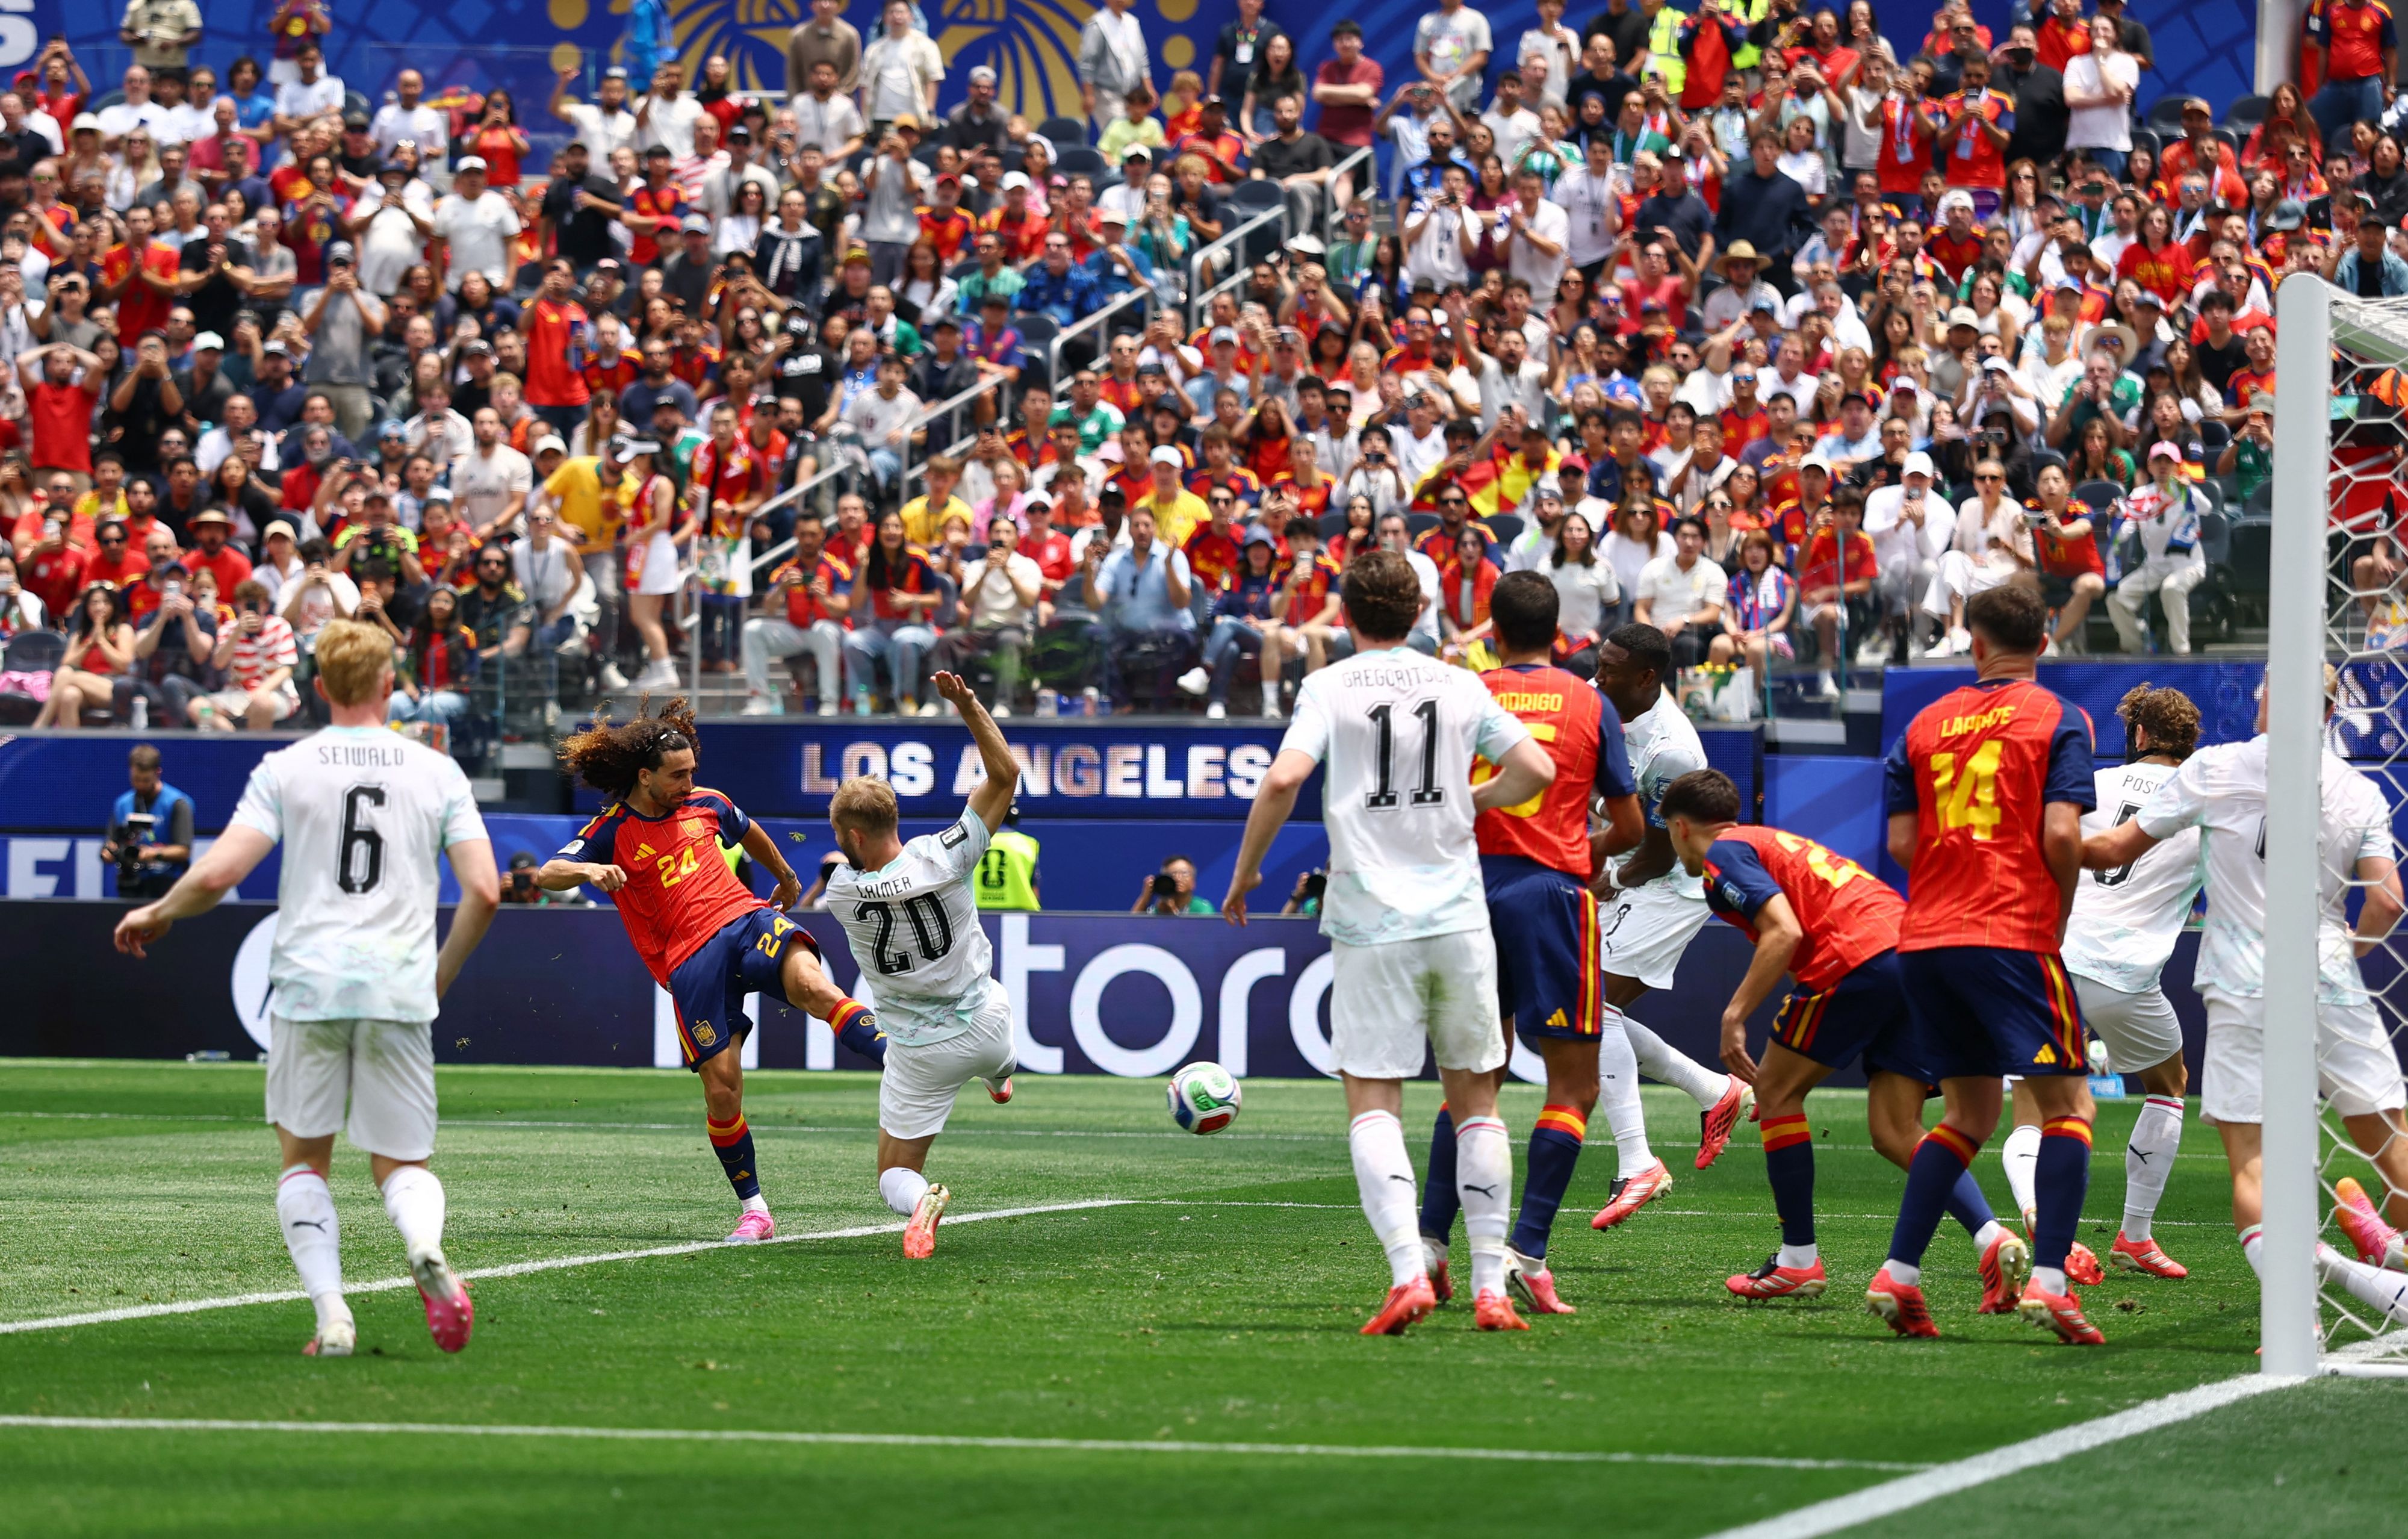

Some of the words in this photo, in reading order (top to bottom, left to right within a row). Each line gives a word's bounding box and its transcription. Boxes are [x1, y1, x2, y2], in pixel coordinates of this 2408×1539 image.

[1492, 693, 1563, 712] ODRIGO
[318, 746, 405, 766] SEIWALD
[801, 741, 934, 795] LOS
[952, 741, 1273, 799] ANGELES
[1365, 697, 1447, 812] 11
[1930, 740, 2002, 847] 14
[336, 781, 392, 900] 6
[657, 845, 700, 889] 24
[856, 877, 912, 898] LAIMER
[756, 916, 795, 959] 24
[854, 891, 956, 976] 20
